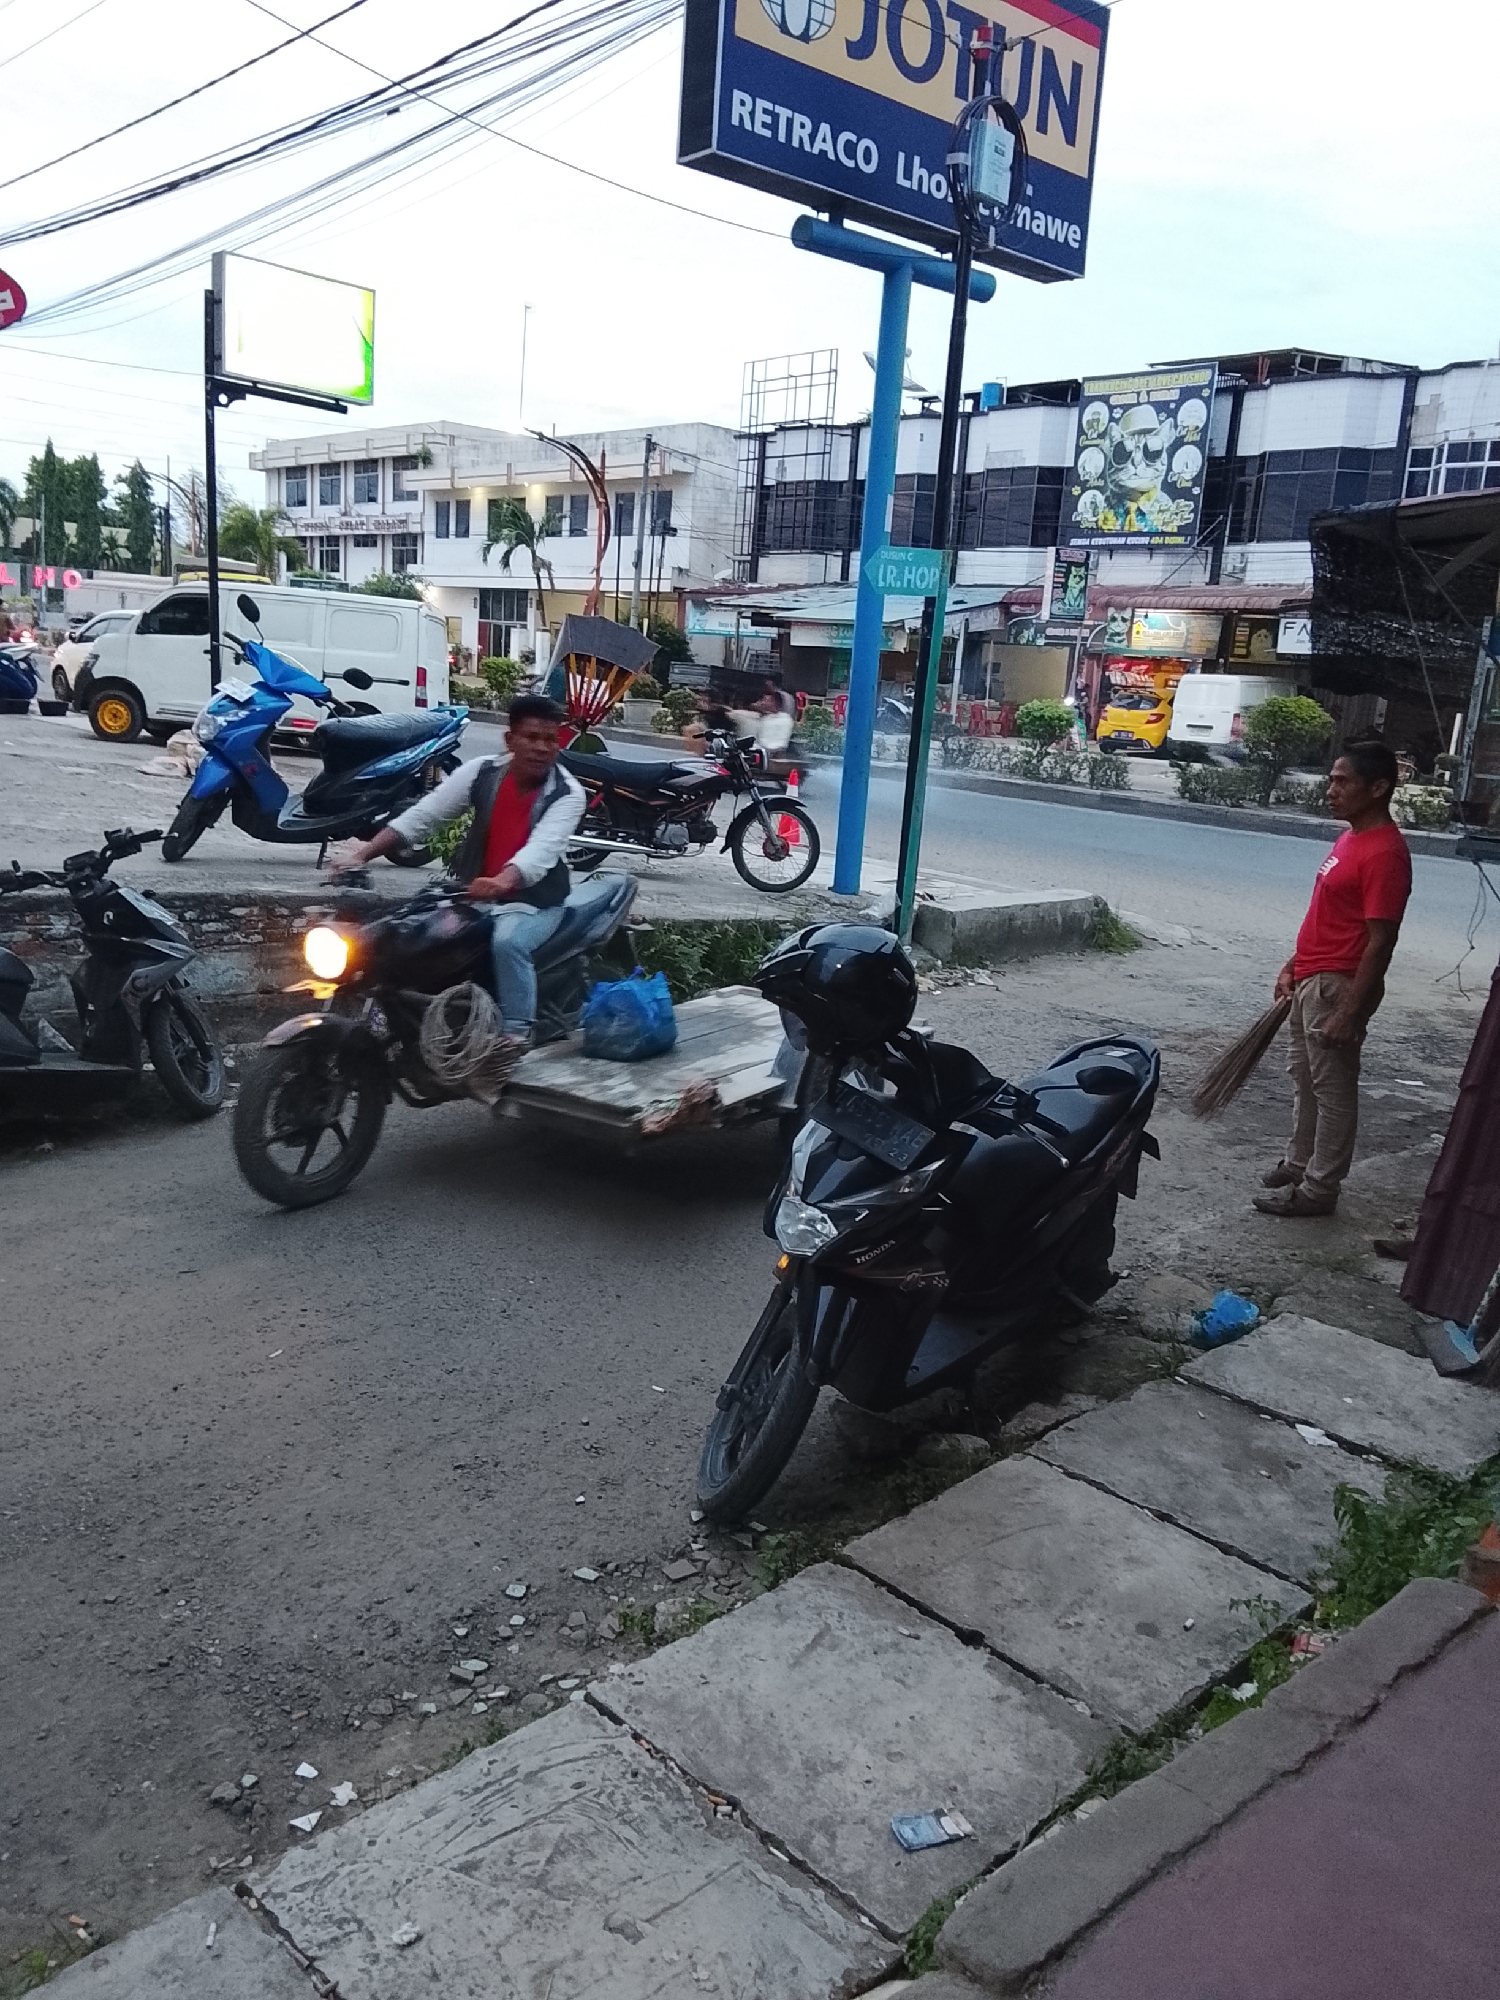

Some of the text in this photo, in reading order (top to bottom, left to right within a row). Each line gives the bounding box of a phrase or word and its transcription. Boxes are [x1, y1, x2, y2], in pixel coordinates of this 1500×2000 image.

[845, 0, 1083, 149] JOTUN
[731, 87, 880, 174] RETRACO
[854, 1238, 897, 1265] HONDA
